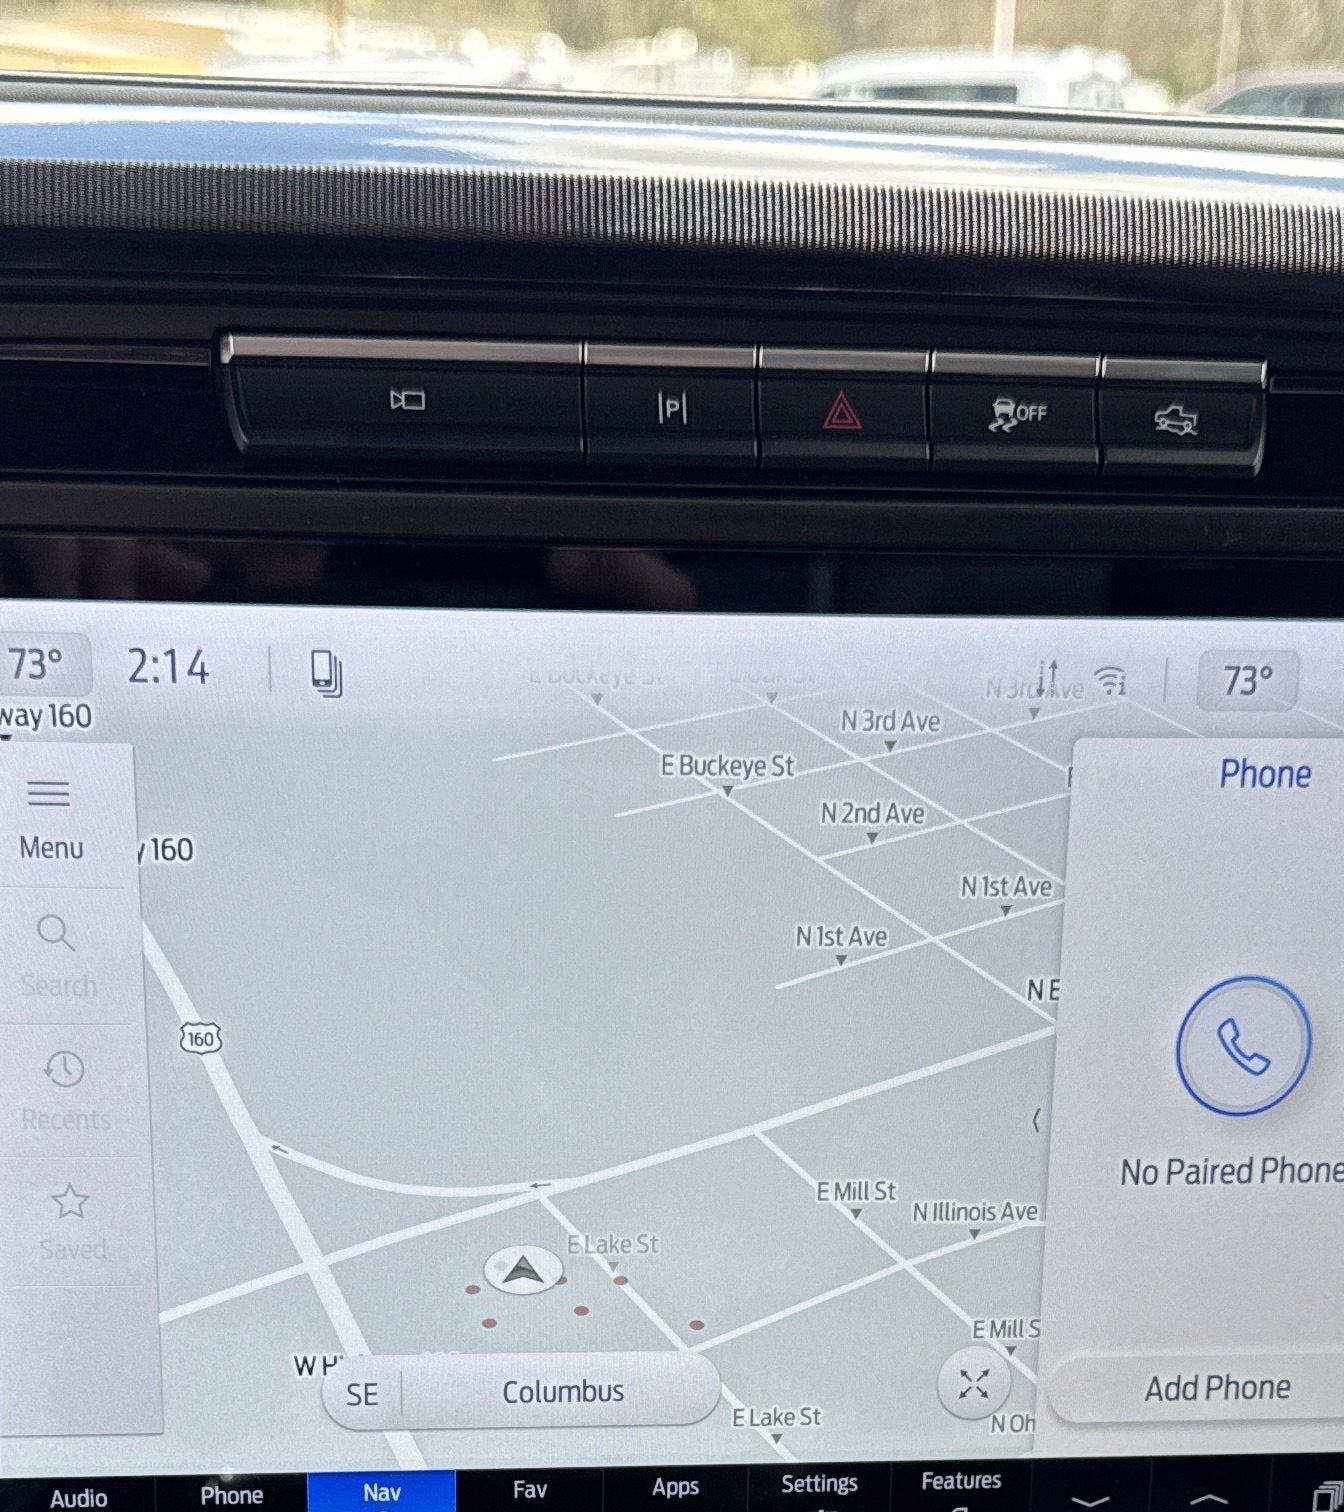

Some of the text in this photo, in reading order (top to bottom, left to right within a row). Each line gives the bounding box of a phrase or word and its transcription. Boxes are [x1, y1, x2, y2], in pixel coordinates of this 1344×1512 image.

[1016, 404, 1048, 421] OFF
[8, 647, 63, 680] 73°
[128, 647, 210, 684] 2:14
[986, 678, 1001, 699] N
[1223, 665, 1273, 696] 73°
[48, 703, 92, 728] 160
[842, 710, 941, 732] N 3rd Ave
[661, 754, 795, 780] E Buckeye St
[1220, 758, 1312, 789] Phone
[821, 803, 925, 824] N 2nd Ave
[19, 835, 84, 860] Menu
[151, 837, 193, 862] 160
[961, 876, 1053, 897] N 1st Ave
[796, 926, 888, 947] N 1st Ave
[20, 973, 98, 999] Search
[1027, 980, 1044, 1001] N
[187, 1031, 215, 1048] 160
[21, 1107, 112, 1132] Recents
[1120, 1157, 1158, 1186] No
[1165, 1156, 1253, 1185] Paired
[816, 1180, 897, 1202] E Mill St
[912, 1201, 1039, 1223] N Illinois Ave
[38, 1238, 108, 1261] Saved
[566, 1233, 660, 1255] E Lake St
[972, 1319, 986, 1340] E
[988, 1319, 1024, 1340] Mill
[292, 1355, 317, 1377] W
[346, 1382, 379, 1407] SE
[502, 1379, 624, 1403] Columbus
[1144, 1373, 1292, 1402] Add Phone
[732, 1406, 822, 1428] E Lake St
[991, 1413, 1007, 1434] N
[513, 1480, 548, 1499] Fav
[653, 1477, 700, 1500] Apps
[781, 1474, 858, 1496] Settings
[921, 1472, 1002, 1490] Features
[50, 1489, 109, 1509] Audio
[200, 1486, 264, 1506] Phone
[363, 1483, 402, 1502] Nav
